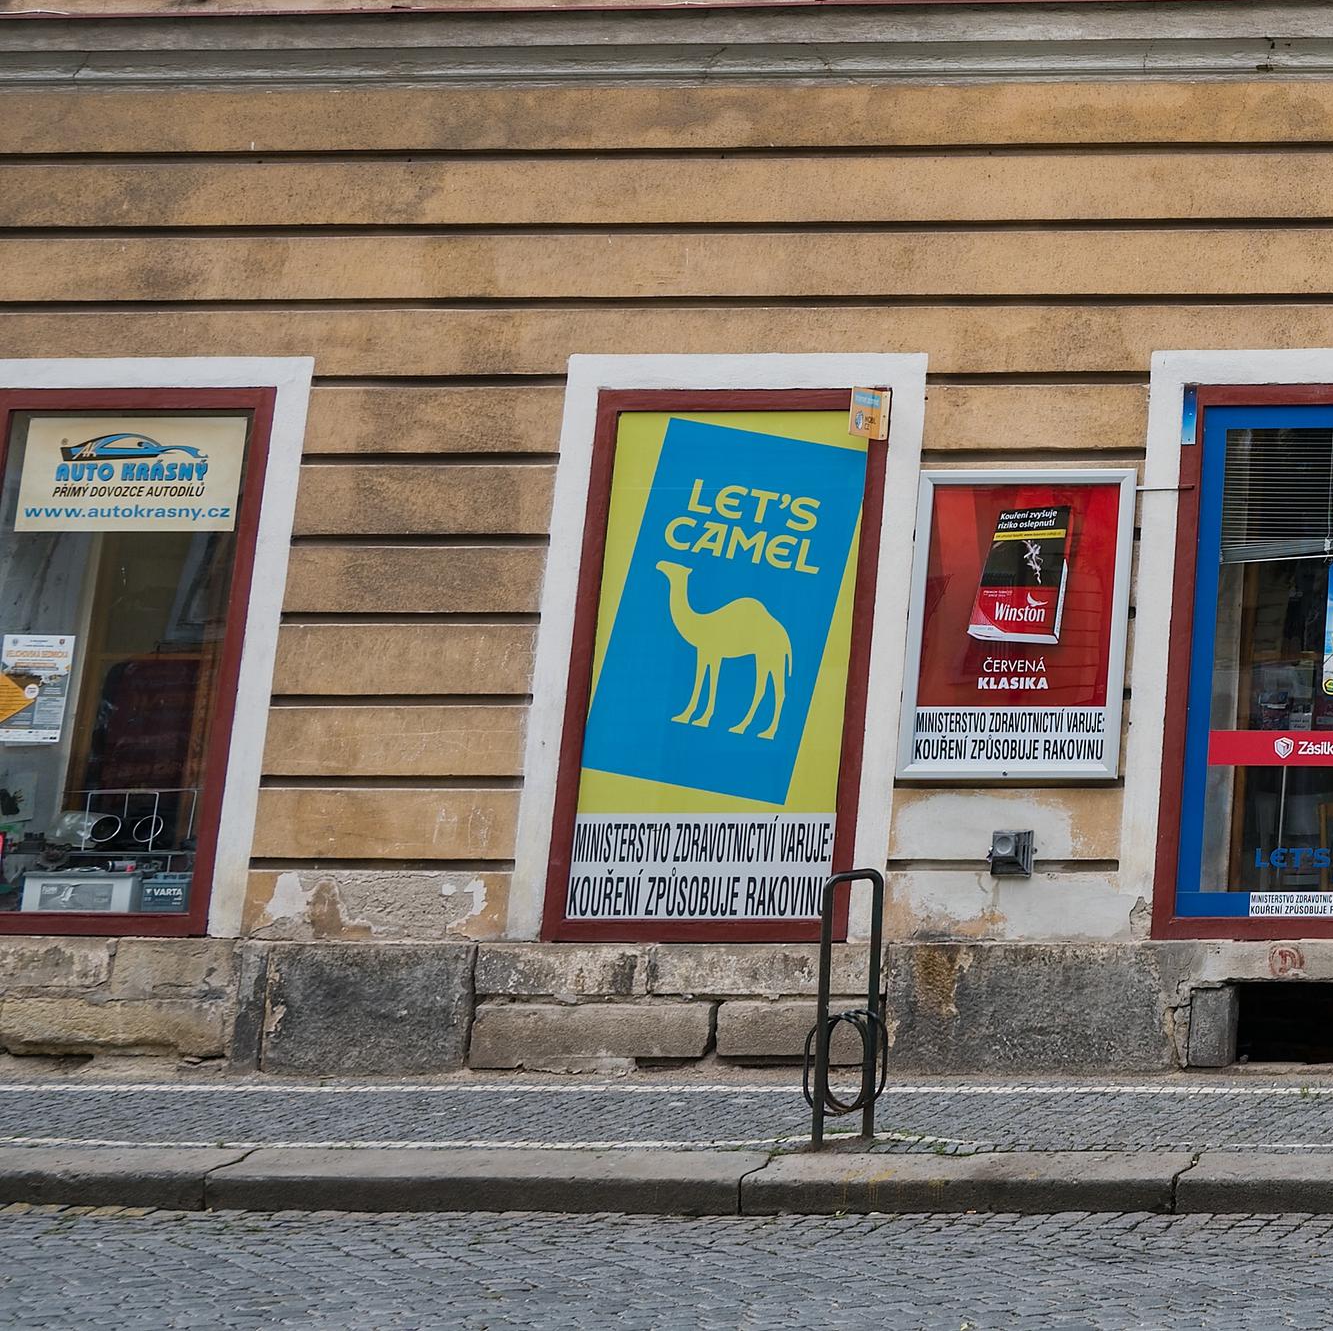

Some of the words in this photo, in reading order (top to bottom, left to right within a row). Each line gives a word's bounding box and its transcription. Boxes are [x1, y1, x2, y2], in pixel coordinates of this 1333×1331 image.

[55, 462, 115, 482] AUTO
[121, 458, 209, 482] KRÁSNÝ
[52, 482, 90, 498] PŘÍMÝ
[89, 485, 145, 498] DOVOZCE
[145, 481, 206, 498] AUTODÍLŮ
[24, 504, 231, 521] www.autokrasny.cz
[687, 478, 821, 532] LET'S
[1000, 510, 1029, 521] Kouření
[1029, 509, 1058, 519] zvyšuje
[997, 520, 1019, 530] riziko
[1019, 518, 1056, 529] oslepnutí
[664, 516, 820, 575] CAMEL
[994, 600, 1046, 623] Winston
[983, 656, 1046, 673] ČERVENÁ
[977, 677, 1049, 690] KLASIKA
[916, 712, 986, 733] MINISTERSTVO
[988, 709, 1066, 733] ZDRAVOTNICTVÍ
[1066, 712, 1105, 733] VARUJE:
[914, 735, 969, 760] KOUŘENÍ
[970, 734, 1039, 760] ZPŮSOBUJE
[1042, 738, 1104, 760] RAKOVINU
[573, 822, 671, 863] MINISTERSTVO
[672, 815, 780, 863] ZDRAVOTNICTVÍ
[779, 822, 833, 863] VARUJE:
[153, 888, 183, 897] VARTA
[567, 868, 644, 917] KOUŘENÍ
[645, 867, 741, 917] ZPŮSOBUJE
[1251, 894, 1295, 904] MINISTERSTVO
[1250, 903, 1283, 915] KOUŘENÍ
[1284, 904, 1327, 915] ZPŮSOBUJE
